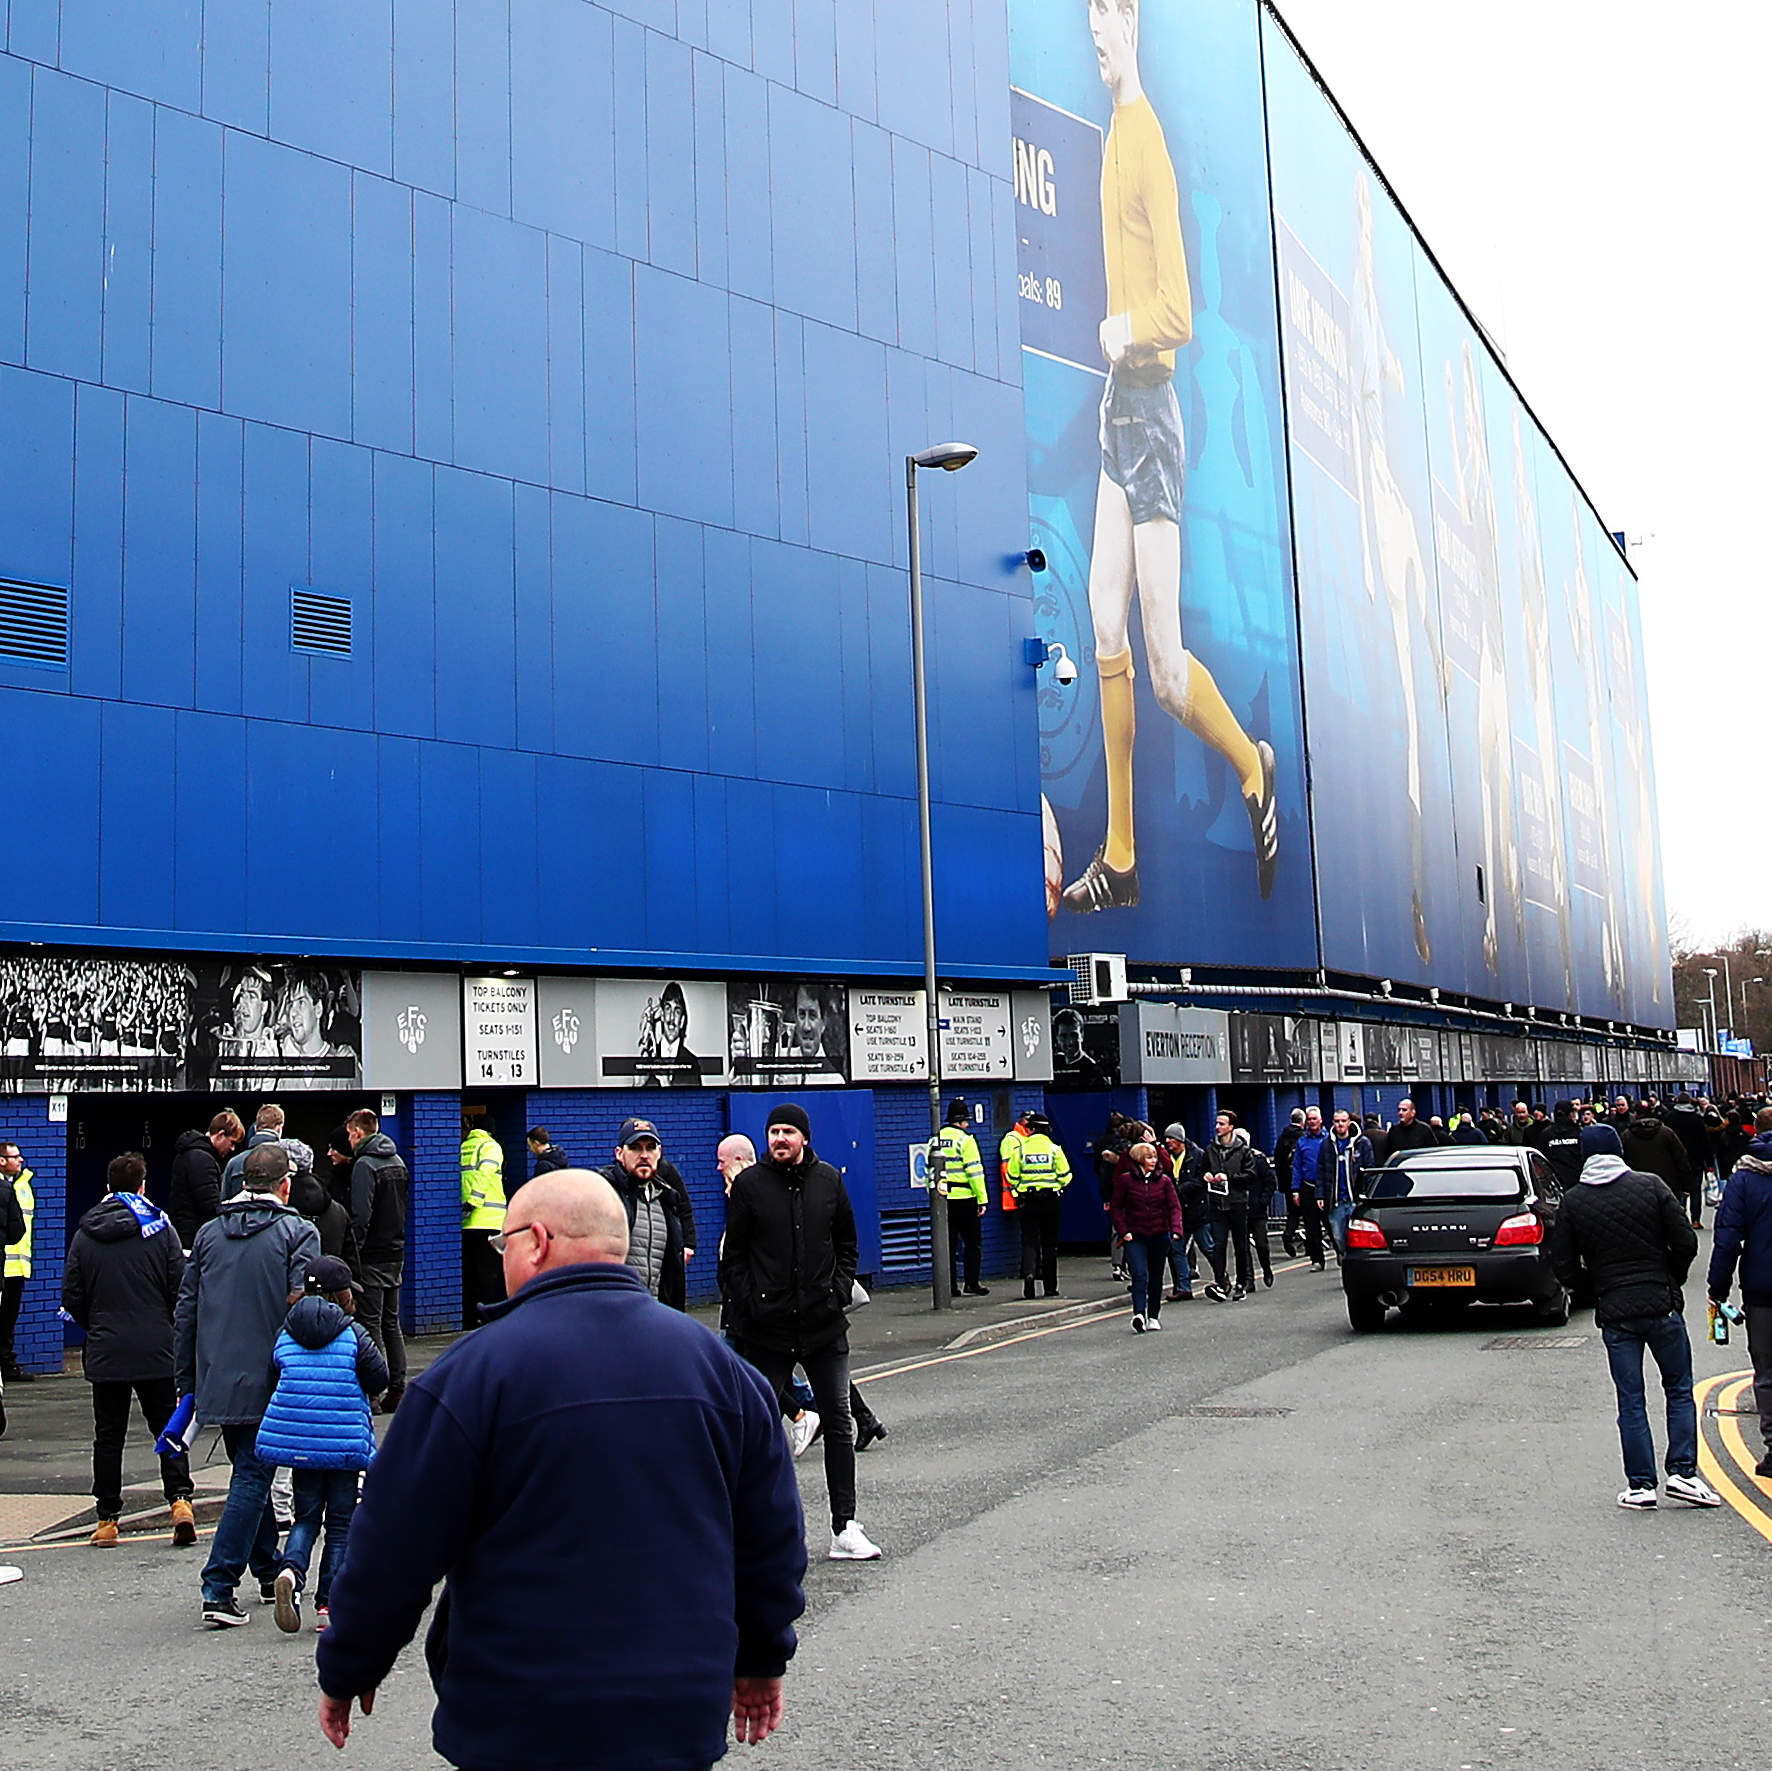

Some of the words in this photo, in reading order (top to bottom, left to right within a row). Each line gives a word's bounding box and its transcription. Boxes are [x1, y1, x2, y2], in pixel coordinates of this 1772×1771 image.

[1045, 276, 1062, 311] 89
[473, 986, 488, 997] TOP
[490, 986, 528, 997] BALCONY
[859, 995, 876, 1006] LATE
[878, 995, 916, 1006] TURNSTILES
[948, 997, 964, 1008] LATE
[964, 998, 1000, 1008] TURNSTILES
[473, 1002, 505, 1013] TICKETS
[507, 1002, 528, 1013] ONLY
[396, 1006, 428, 1030] EFC
[552, 1009, 581, 1031] EFC
[479, 1024, 504, 1035] SEATS
[505, 1024, 523, 1035] 1-151
[879, 1037, 907, 1046] TURNSTILE
[908, 1036, 916, 1047] 13
[957, 1037, 984, 1046] TURNSTILE
[1146, 1030, 1179, 1059] EVERTON
[1180, 1032, 1216, 1059] RECEPTION
[477, 1049, 526, 1060] TURNSTILES
[481, 1064, 493, 1078] 14
[511, 1063, 523, 1078] 13
[880, 1064, 908, 1073] TURNSTILE
[909, 1063, 915, 1074] 6
[959, 1064, 984, 1073] TURNSTILE
[985, 1062, 991, 1073] 6
[51, 1102, 66, 1113] X11
[1025, 1154, 1049, 1164] POLICE
[1412, 1224, 1468, 1233] SUBARU
[1413, 1270, 1445, 1283] DG54
[1447, 1269, 1472, 1282] HRU
